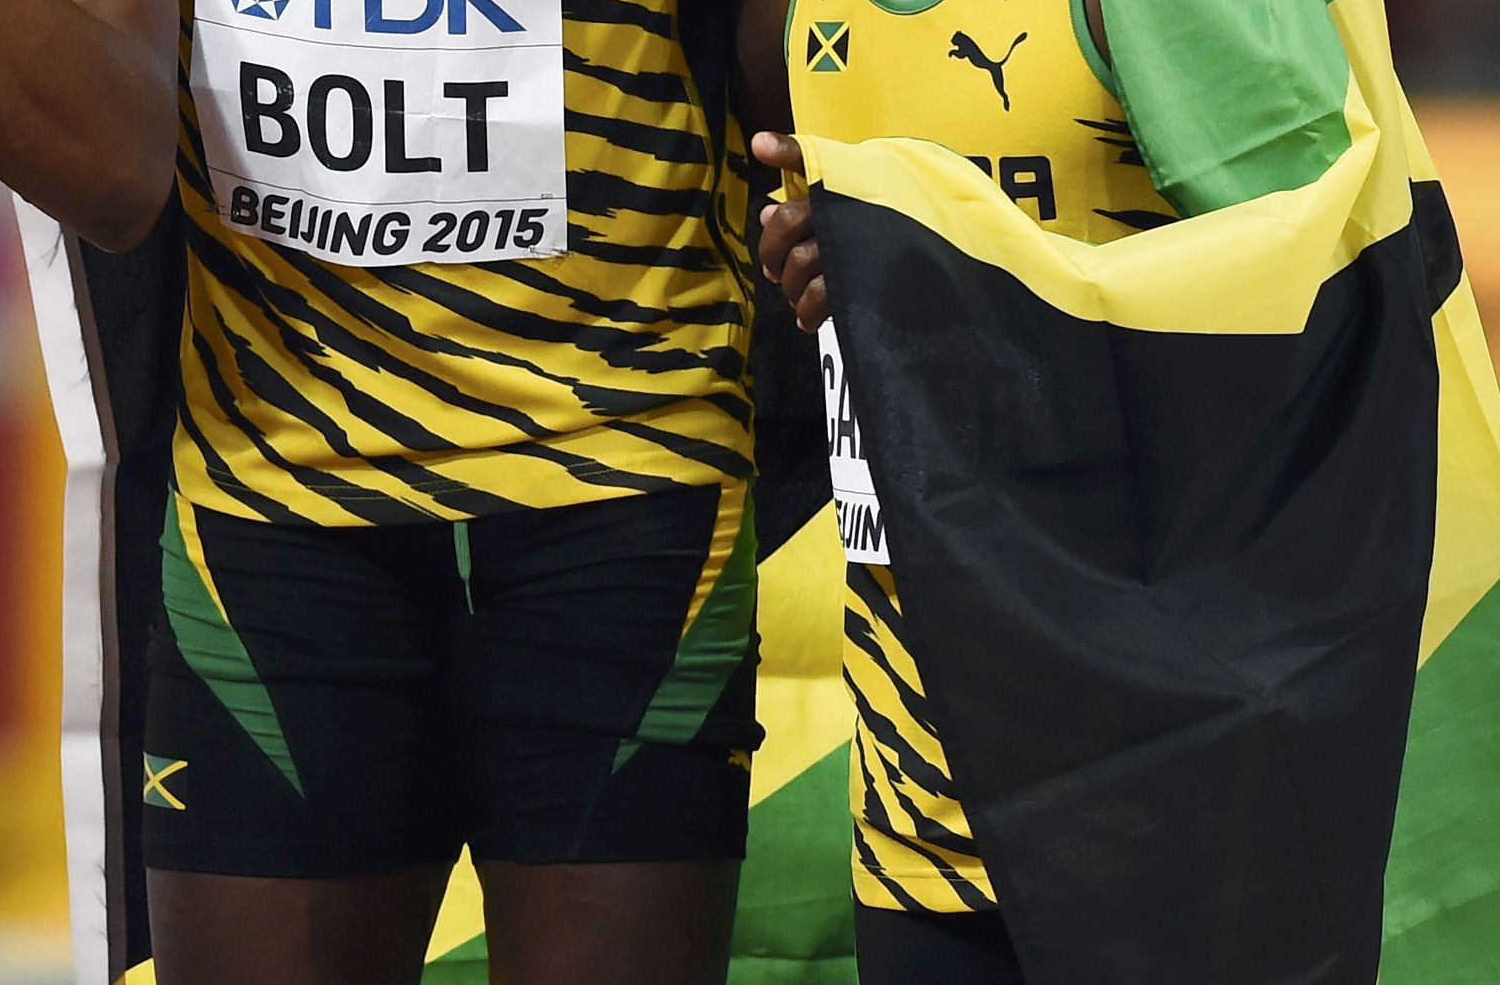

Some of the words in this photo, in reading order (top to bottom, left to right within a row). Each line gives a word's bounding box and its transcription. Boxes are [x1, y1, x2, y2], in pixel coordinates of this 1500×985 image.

[238, 61, 509, 175] BOLT
[230, 186, 411, 256] BEIJING
[421, 207, 548, 254] 2015
